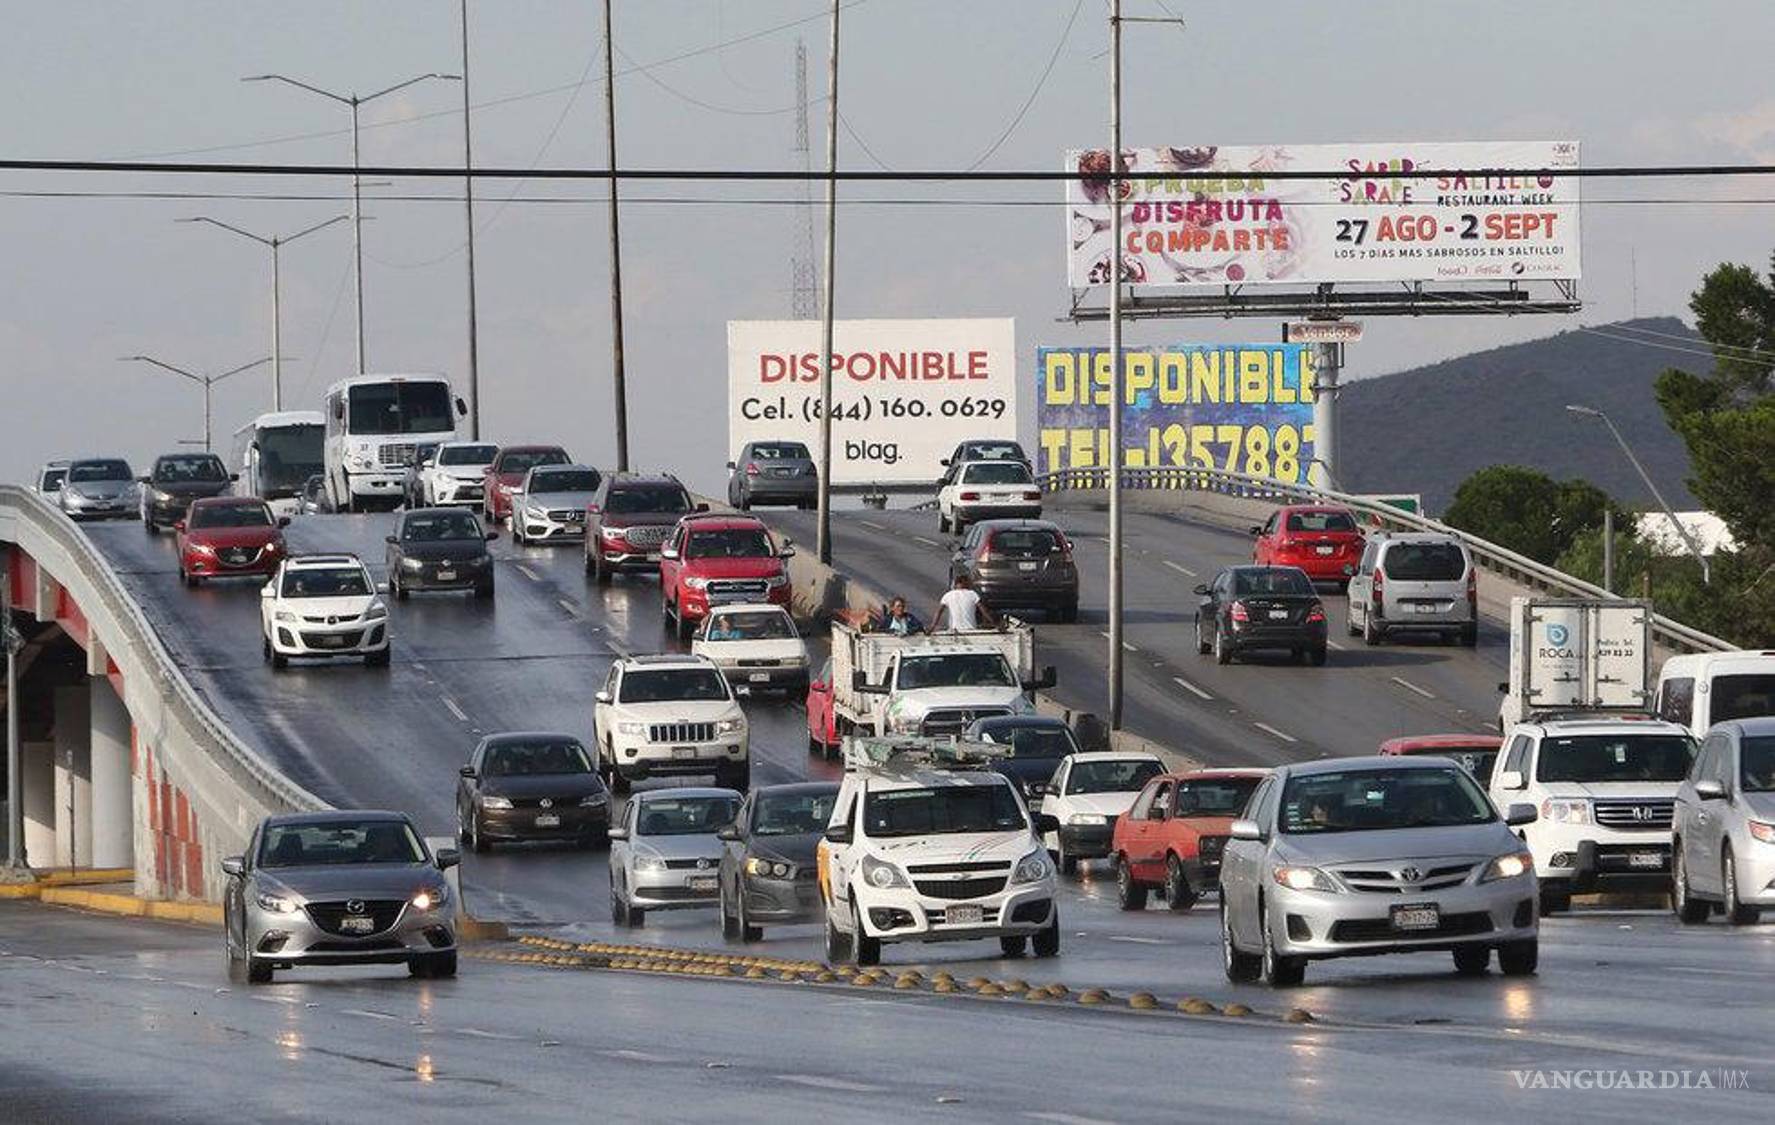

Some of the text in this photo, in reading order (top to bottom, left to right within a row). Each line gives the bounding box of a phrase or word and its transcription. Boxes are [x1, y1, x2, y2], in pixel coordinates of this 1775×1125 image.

[1437, 169, 1554, 190] SALTILLO
[1131, 198, 1284, 223] DISFRUTA
[1437, 193, 1554, 207] RESTAURANT WEEK
[1126, 228, 1289, 254] COMPARTE
[1336, 220, 1369, 245] 27
[1376, 215, 1438, 242] AGO
[1460, 214, 1479, 240] 2
[1484, 213, 1558, 240] SEPT
[1334, 250, 1356, 259] LOS
[1426, 247, 1486, 257] SABROSOS
[1490, 247, 1504, 256] EN
[760, 352, 990, 383] DISPONIBLE
[741, 396, 1006, 423] Cel. (844) 160. 0629
[845, 440, 903, 465] blag.
[1539, 648, 1574, 658] ROCA
